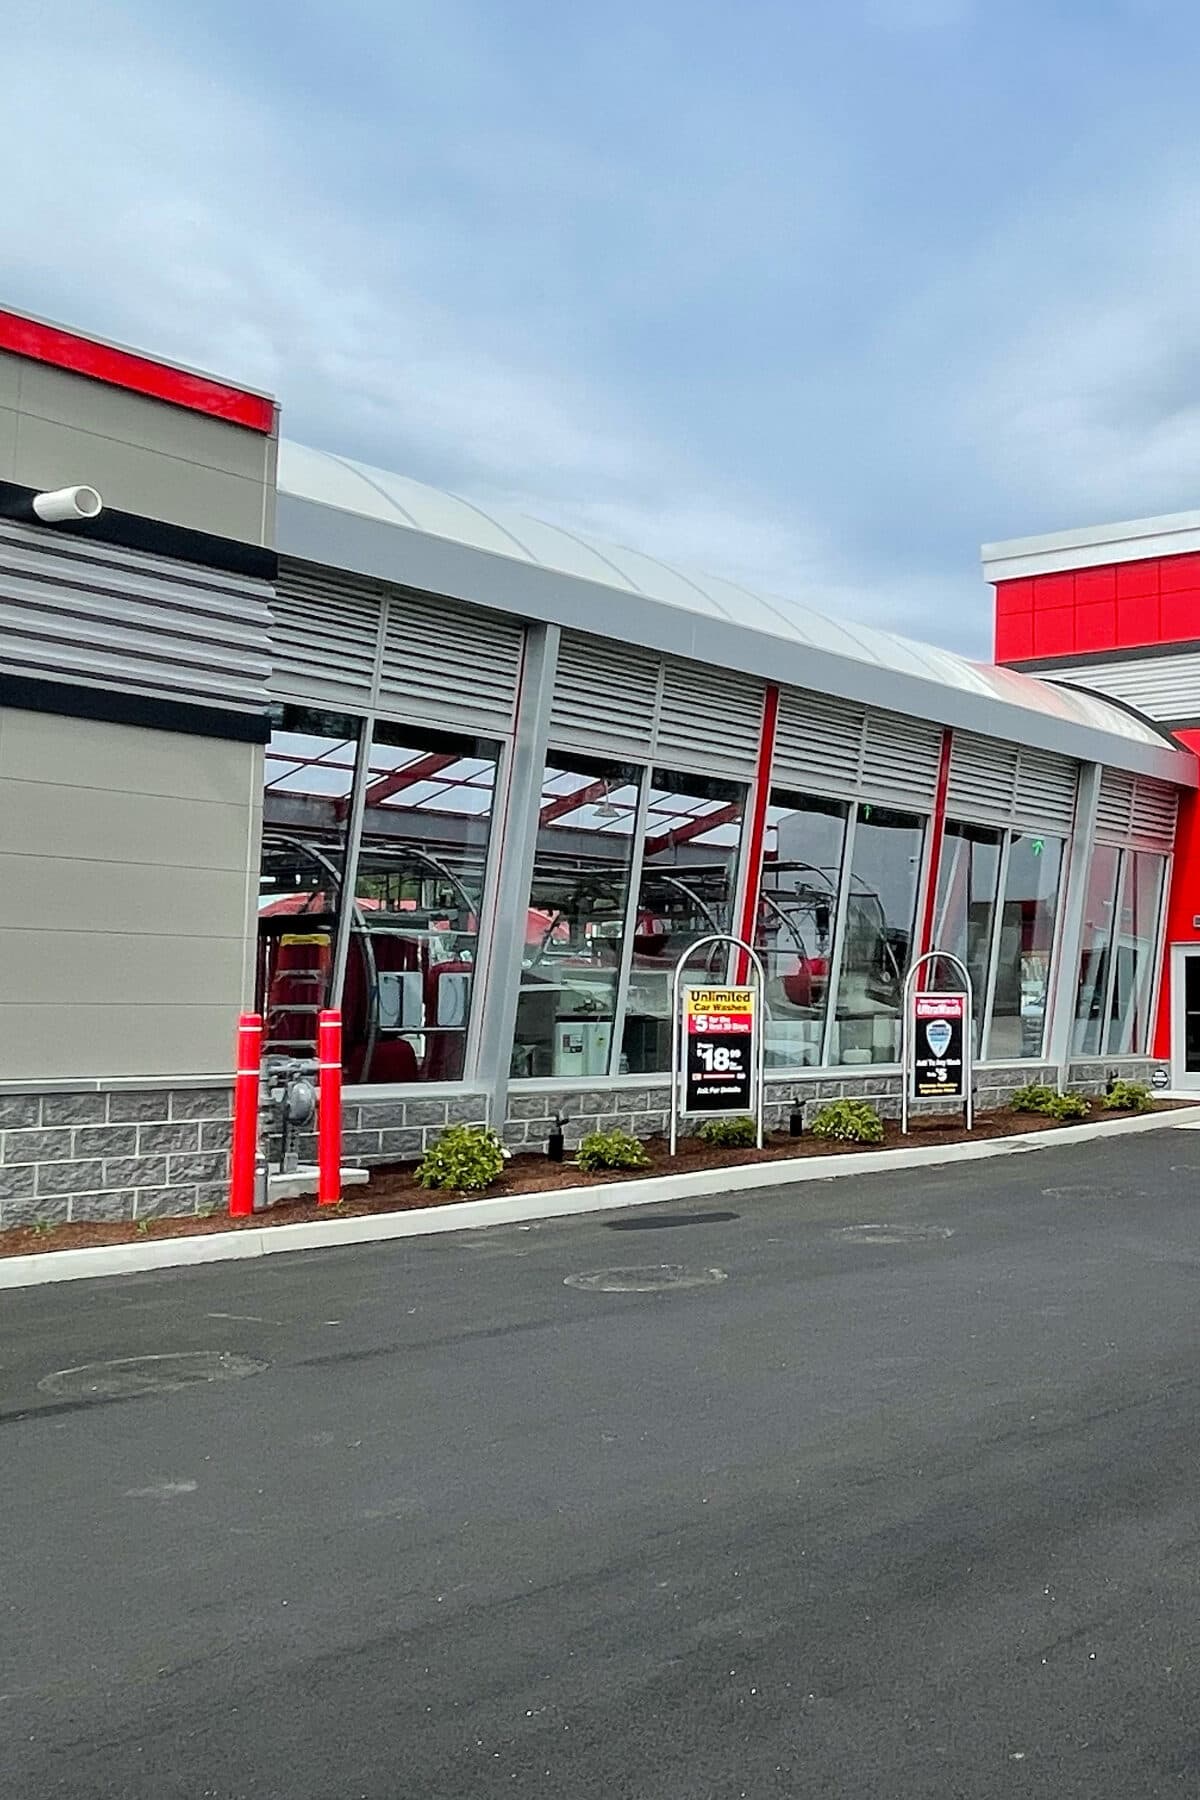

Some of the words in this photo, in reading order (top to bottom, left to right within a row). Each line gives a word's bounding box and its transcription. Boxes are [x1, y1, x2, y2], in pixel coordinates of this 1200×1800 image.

[691, 990, 751, 1002] Unlimited
[694, 1003, 710, 1011] Car
[713, 1003, 748, 1011] Washes
